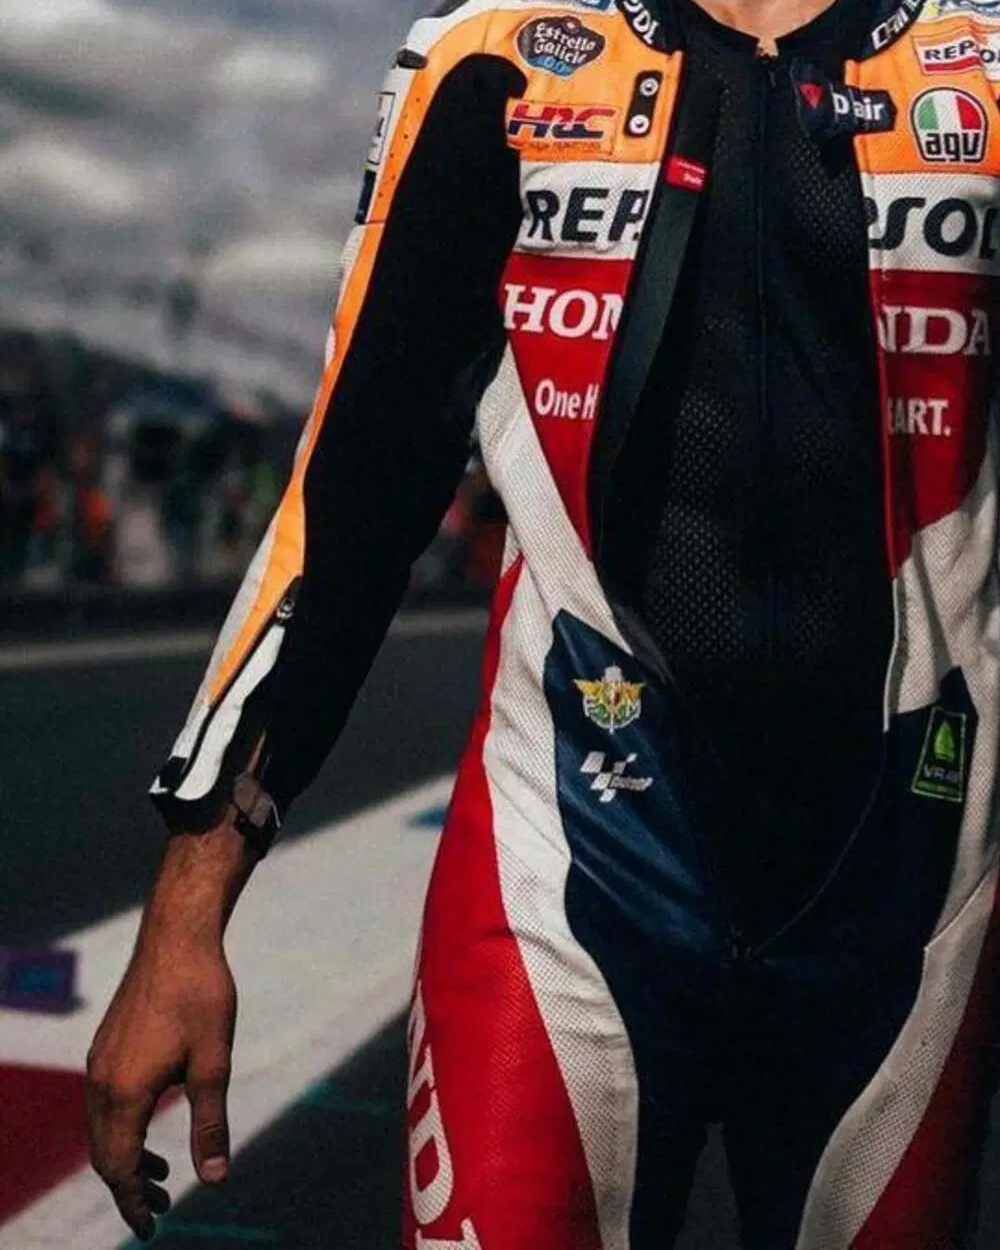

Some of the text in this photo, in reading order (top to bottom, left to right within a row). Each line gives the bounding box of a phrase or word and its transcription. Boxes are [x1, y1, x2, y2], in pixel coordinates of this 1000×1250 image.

[508, 103, 616, 138] HRC
[925, 132, 980, 163] agv
[534, 378, 580, 420] One
